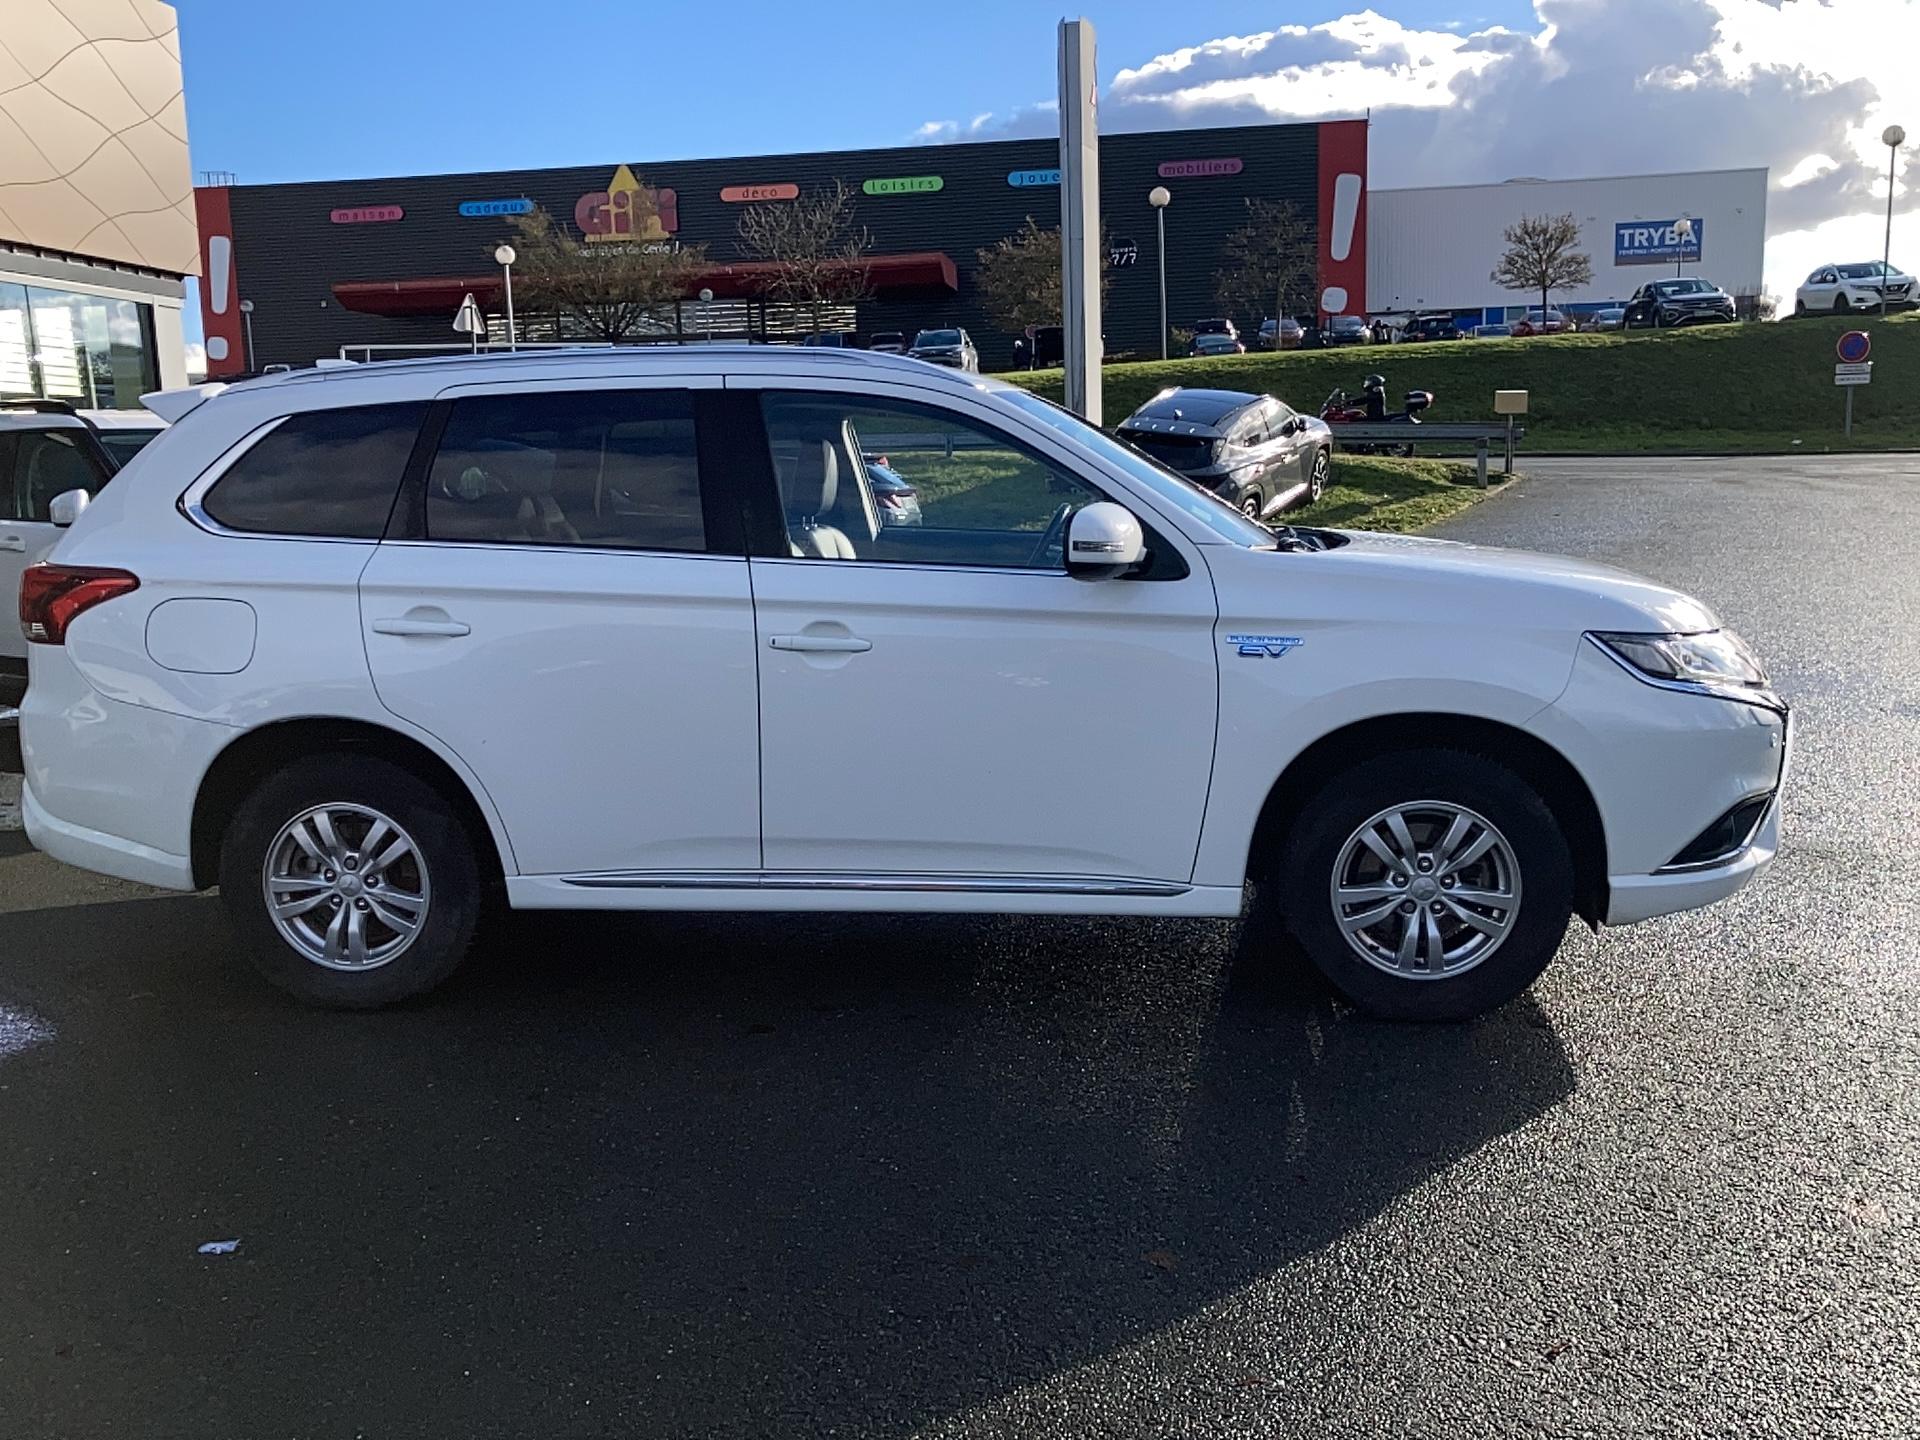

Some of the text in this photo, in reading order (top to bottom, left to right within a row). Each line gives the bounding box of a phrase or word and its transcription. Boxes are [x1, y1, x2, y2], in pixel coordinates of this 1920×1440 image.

[1163, 161, 1237, 176] mobiliers
[1019, 172, 1061, 185] joue
[872, 179, 934, 193] loisirs
[338, 210, 396, 221] maison
[1619, 225, 1698, 248] TRYBA
[1111, 252, 1137, 266] 7/7
[1237, 644, 1293, 658] EV
